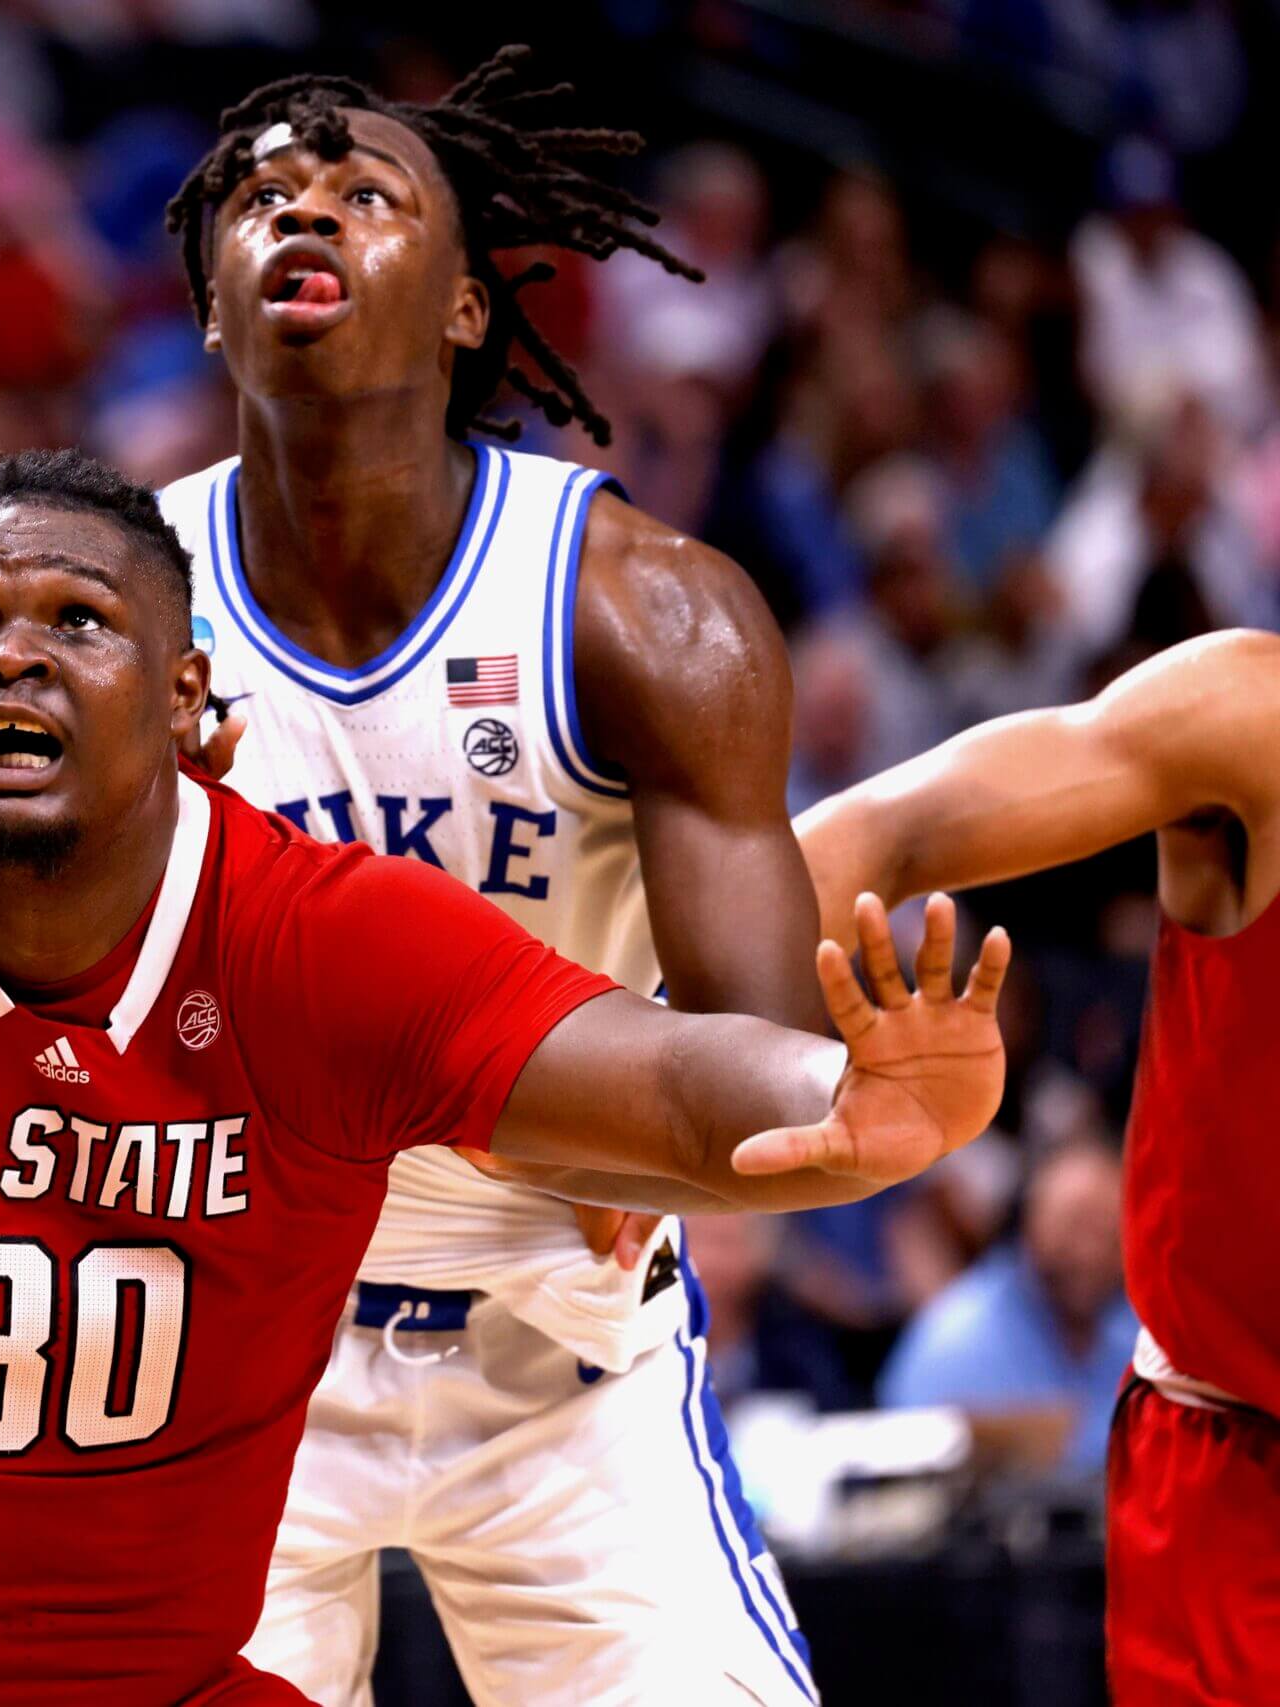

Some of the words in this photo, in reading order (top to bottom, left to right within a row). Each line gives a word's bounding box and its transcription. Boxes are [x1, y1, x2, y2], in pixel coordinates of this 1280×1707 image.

[472, 735, 513, 753] ACC
[275, 790, 557, 900] KE
[182, 1006, 217, 1029] ACC
